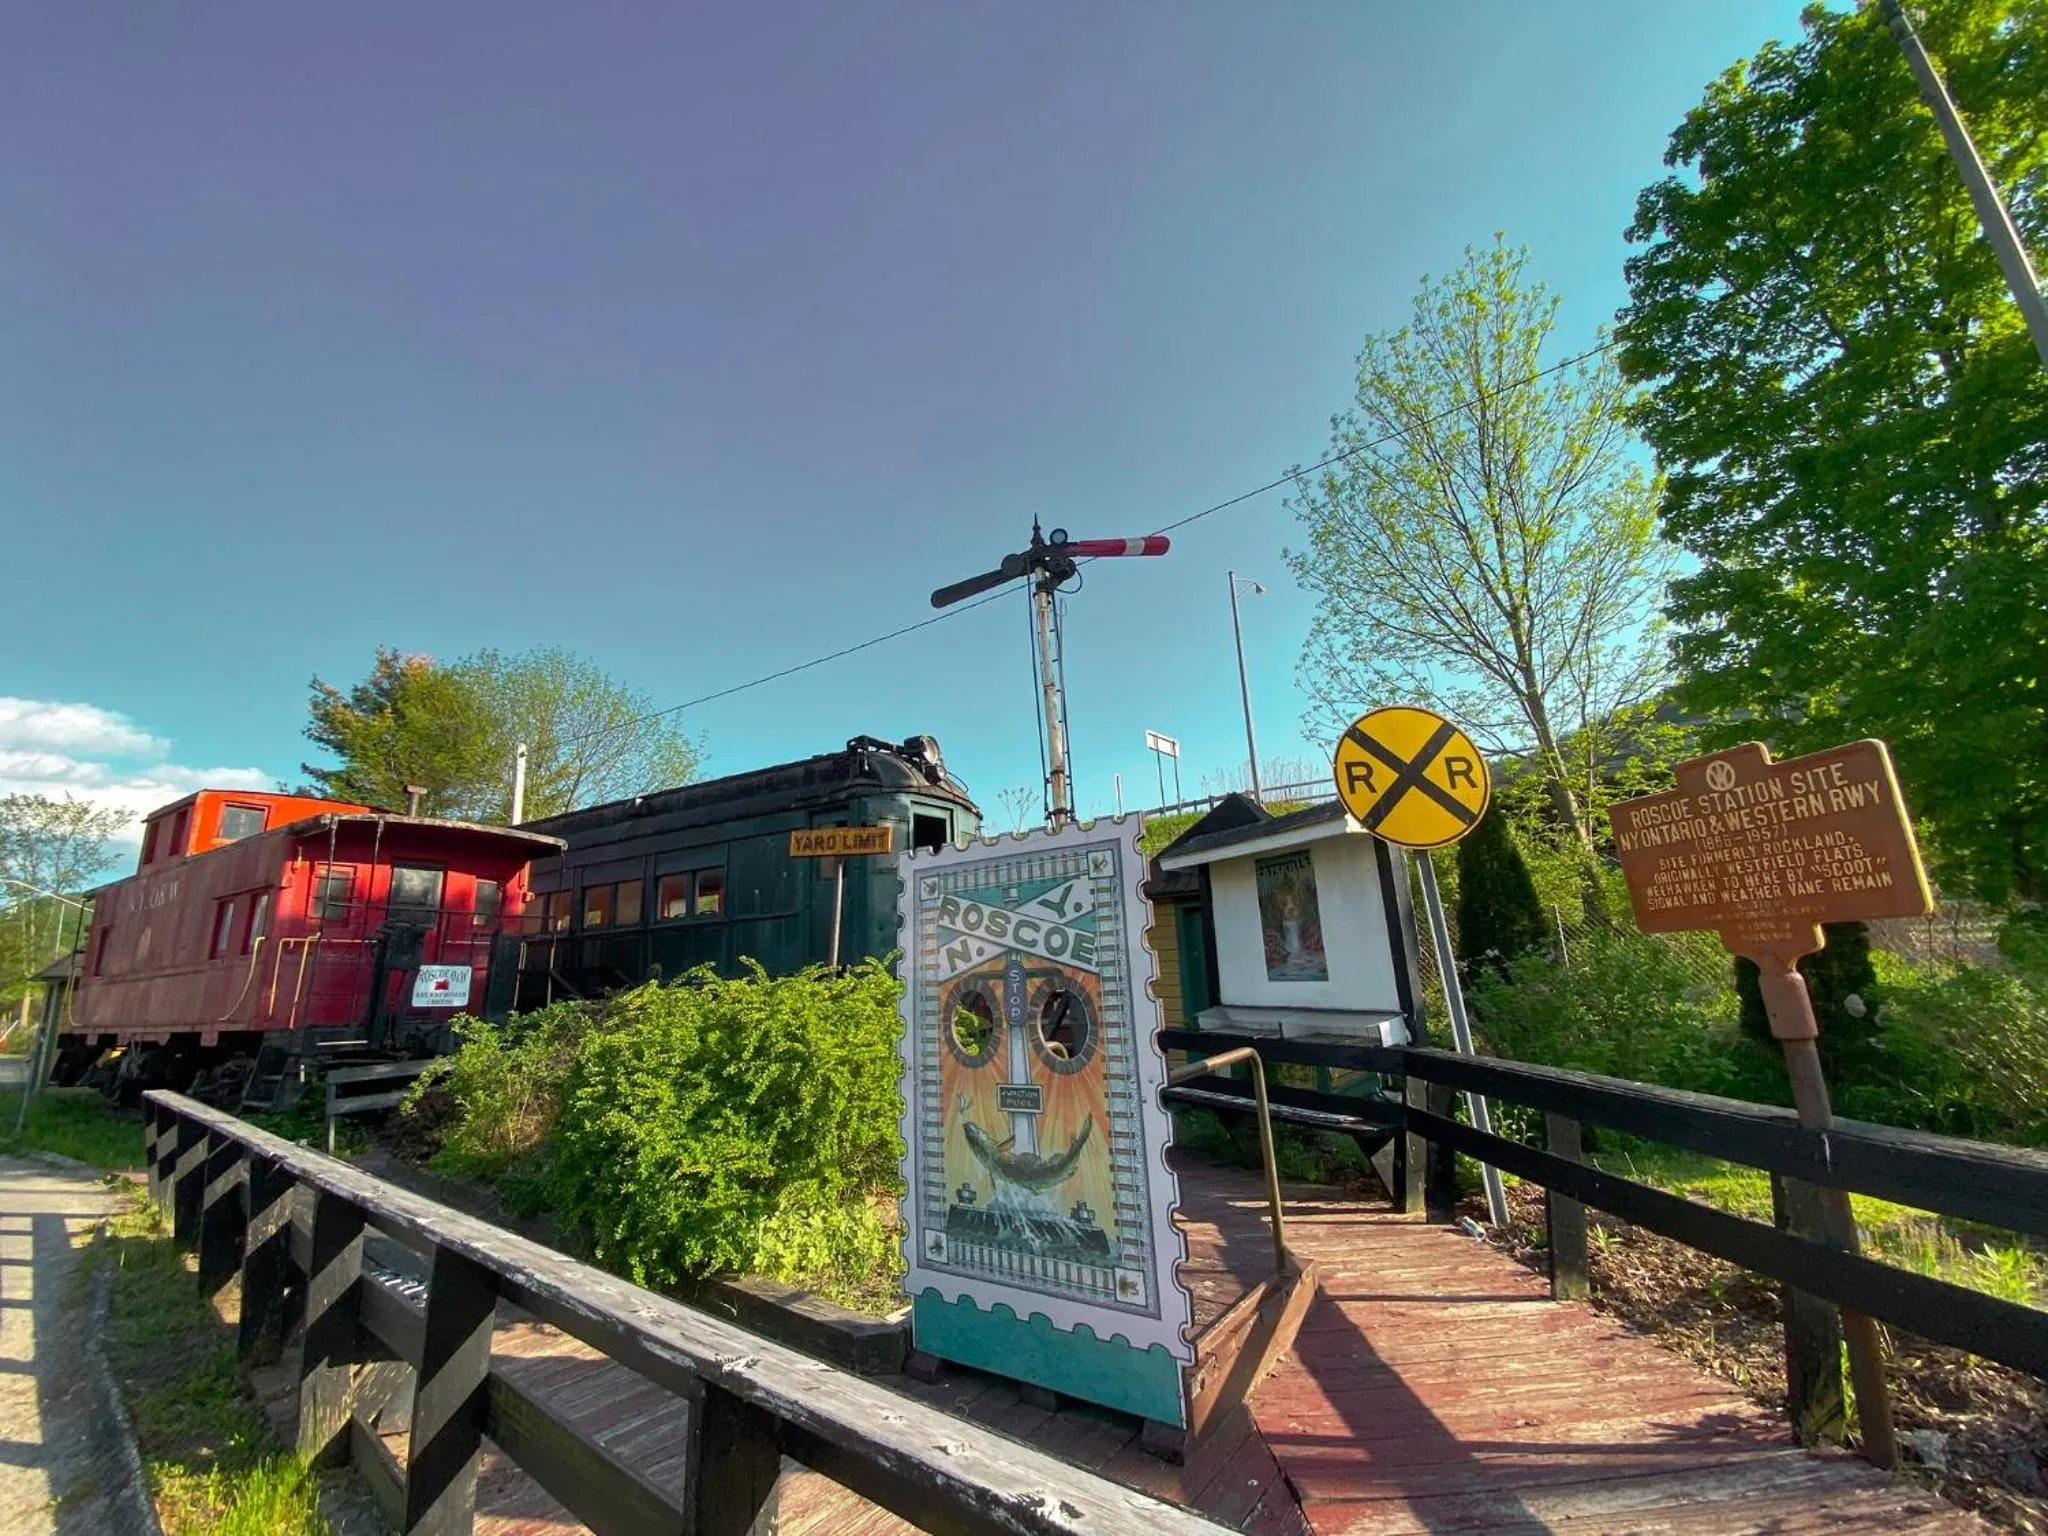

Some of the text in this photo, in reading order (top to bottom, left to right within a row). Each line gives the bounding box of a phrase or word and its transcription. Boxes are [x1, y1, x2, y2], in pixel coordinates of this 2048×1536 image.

[1344, 756, 1478, 795] R R
[1630, 762, 1848, 829] ROSCOE STATION SITE
[1724, 793, 1826, 832] WESTERN
[1828, 780, 1880, 812] RWY
[794, 831, 887, 851] YARD LIMIT
[1660, 855, 1686, 871] SITE
[1690, 844, 1756, 867] FORMERLY
[1654, 864, 1720, 884] ORIGINALLY
[1727, 852, 1805, 875] WESTFIELD
[1722, 876, 1740, 889] TO
[1744, 870, 1781, 888] HERE
[1787, 868, 1804, 882] BY
[1647, 871, 1893, 911] SIGNAL AND WEATHER VANE REMAIN
[937, 895, 1096, 965] ROSCOE
[945, 938, 986, 973] N.
[1009, 970, 1021, 1018] STOP
